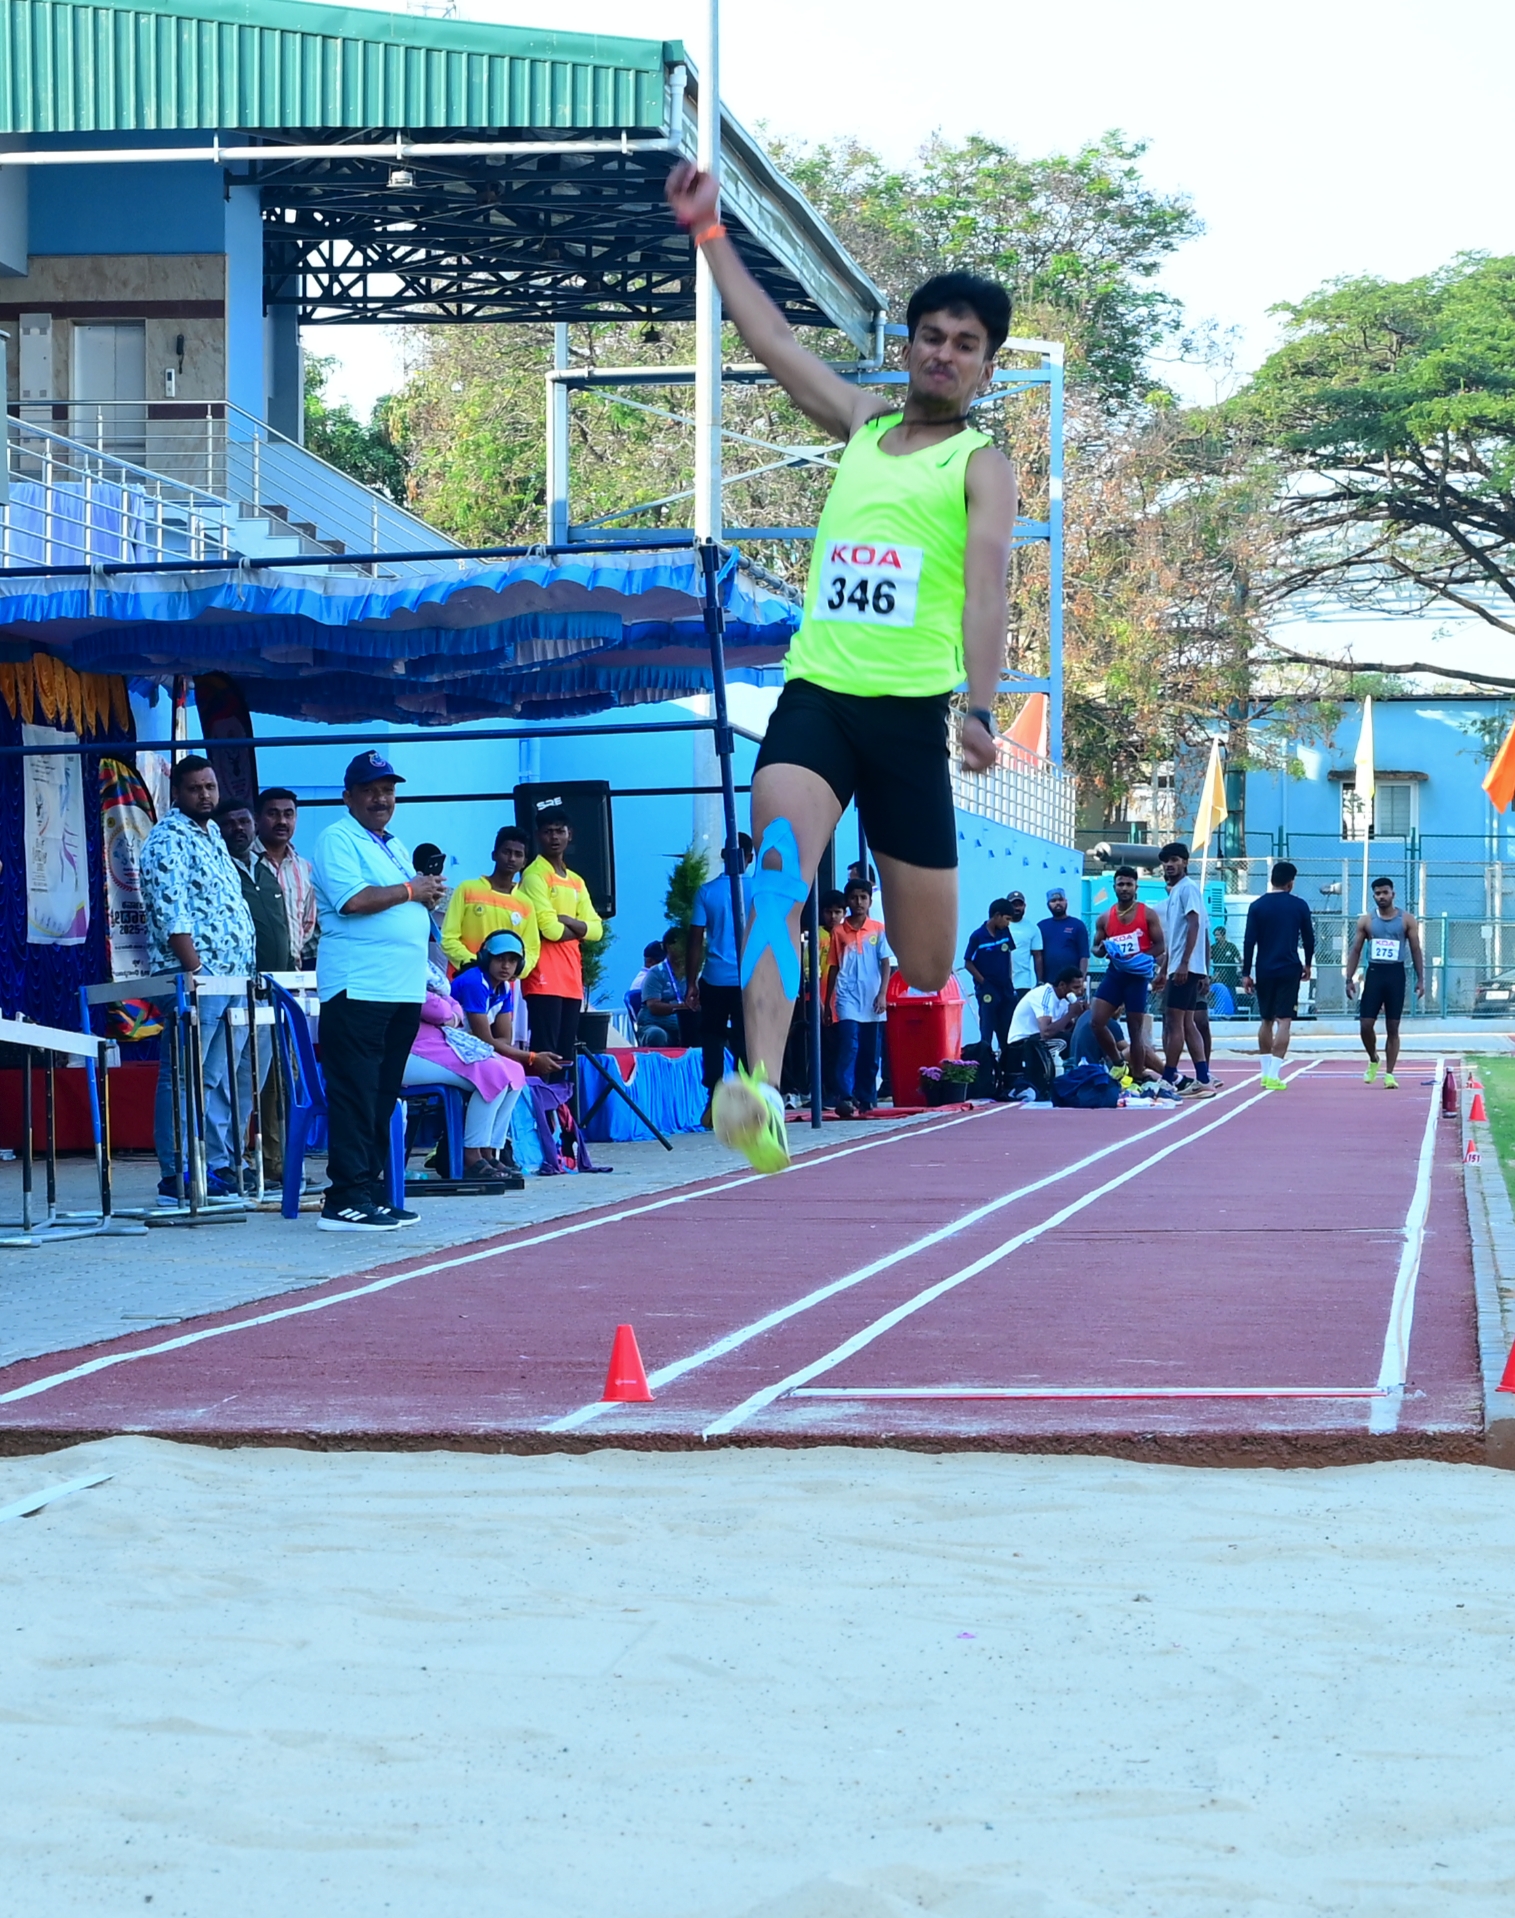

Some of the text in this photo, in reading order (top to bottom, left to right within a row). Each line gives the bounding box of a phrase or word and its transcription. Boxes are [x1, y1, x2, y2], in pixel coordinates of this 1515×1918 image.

[831, 544, 902, 569] KOA
[827, 577, 897, 615] 346
[1117, 942, 1134, 953] 72
[1376, 947, 1394, 958] 275
